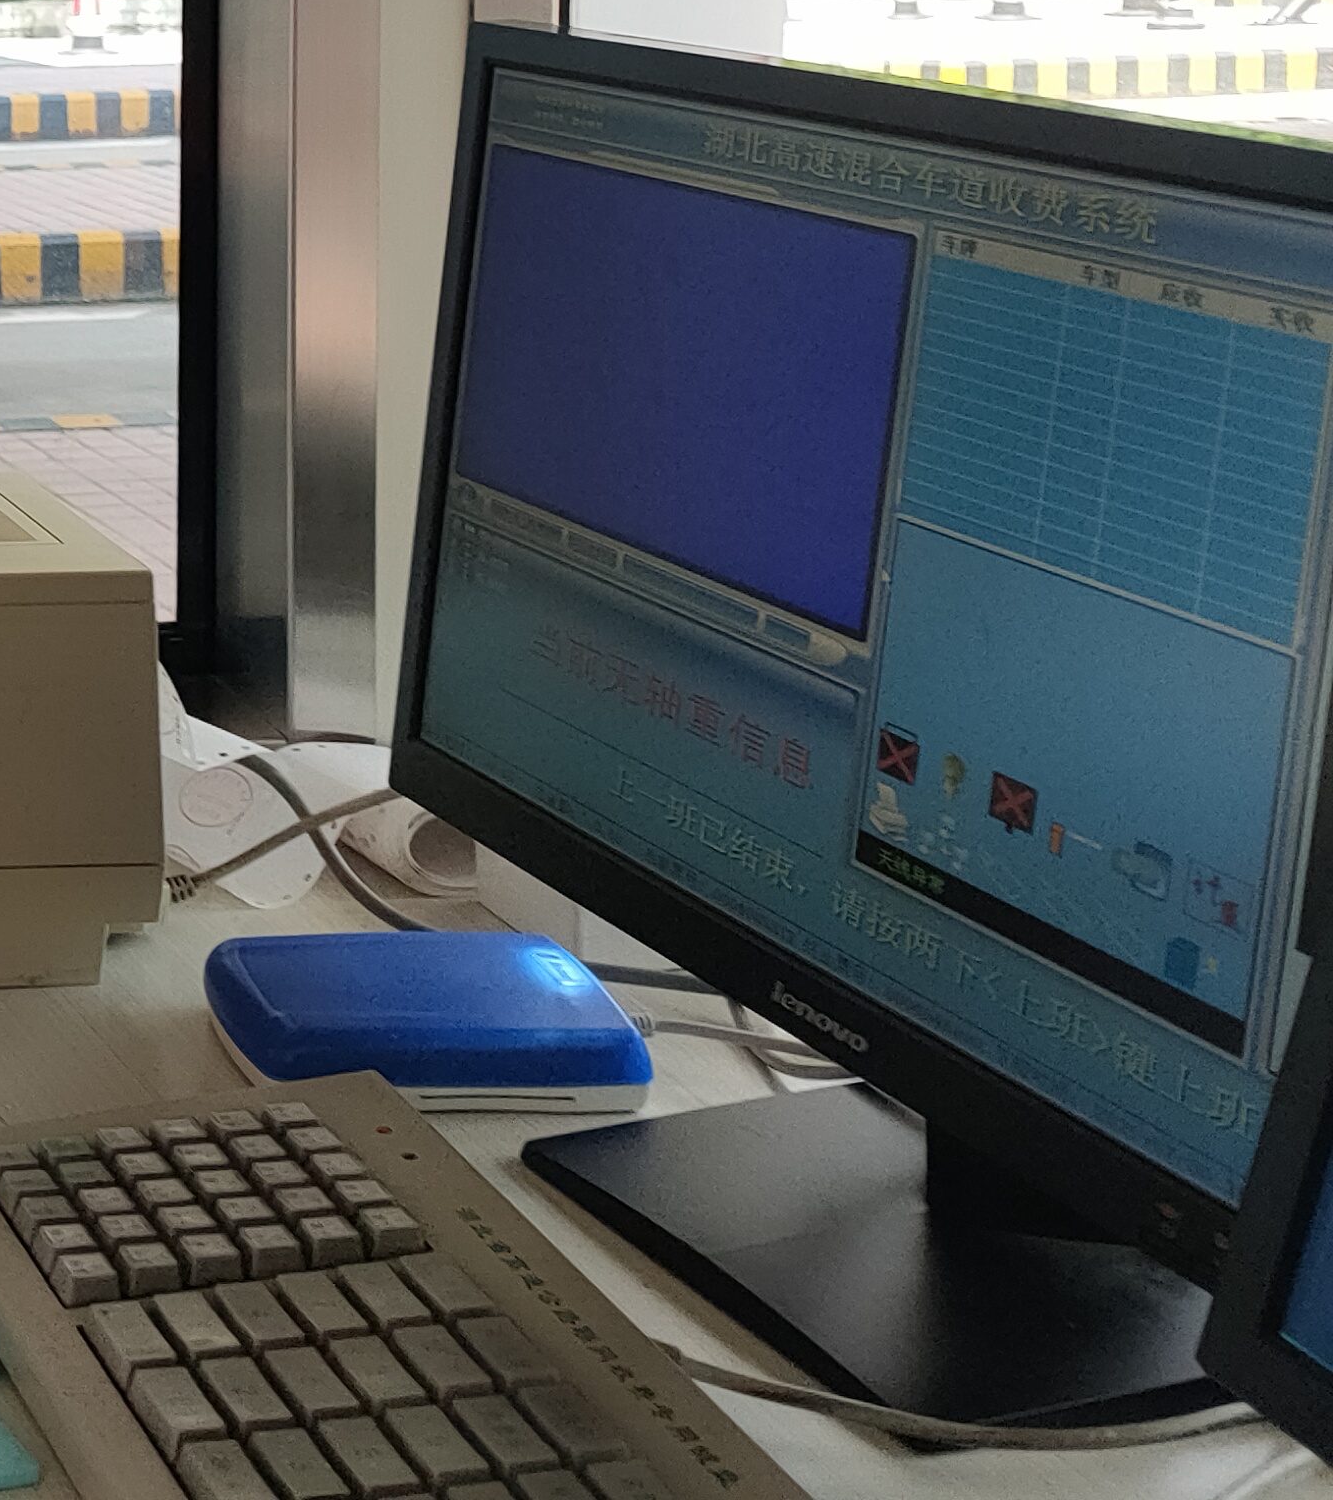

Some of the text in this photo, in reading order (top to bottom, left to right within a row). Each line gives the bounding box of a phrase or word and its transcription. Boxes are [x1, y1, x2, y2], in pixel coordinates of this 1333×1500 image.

[702, 123, 1158, 245] 湖北高速混合车道收费系统
[528, 623, 814, 791] 当前无轴重信息
[770, 979, 870, 1053] lenovo
